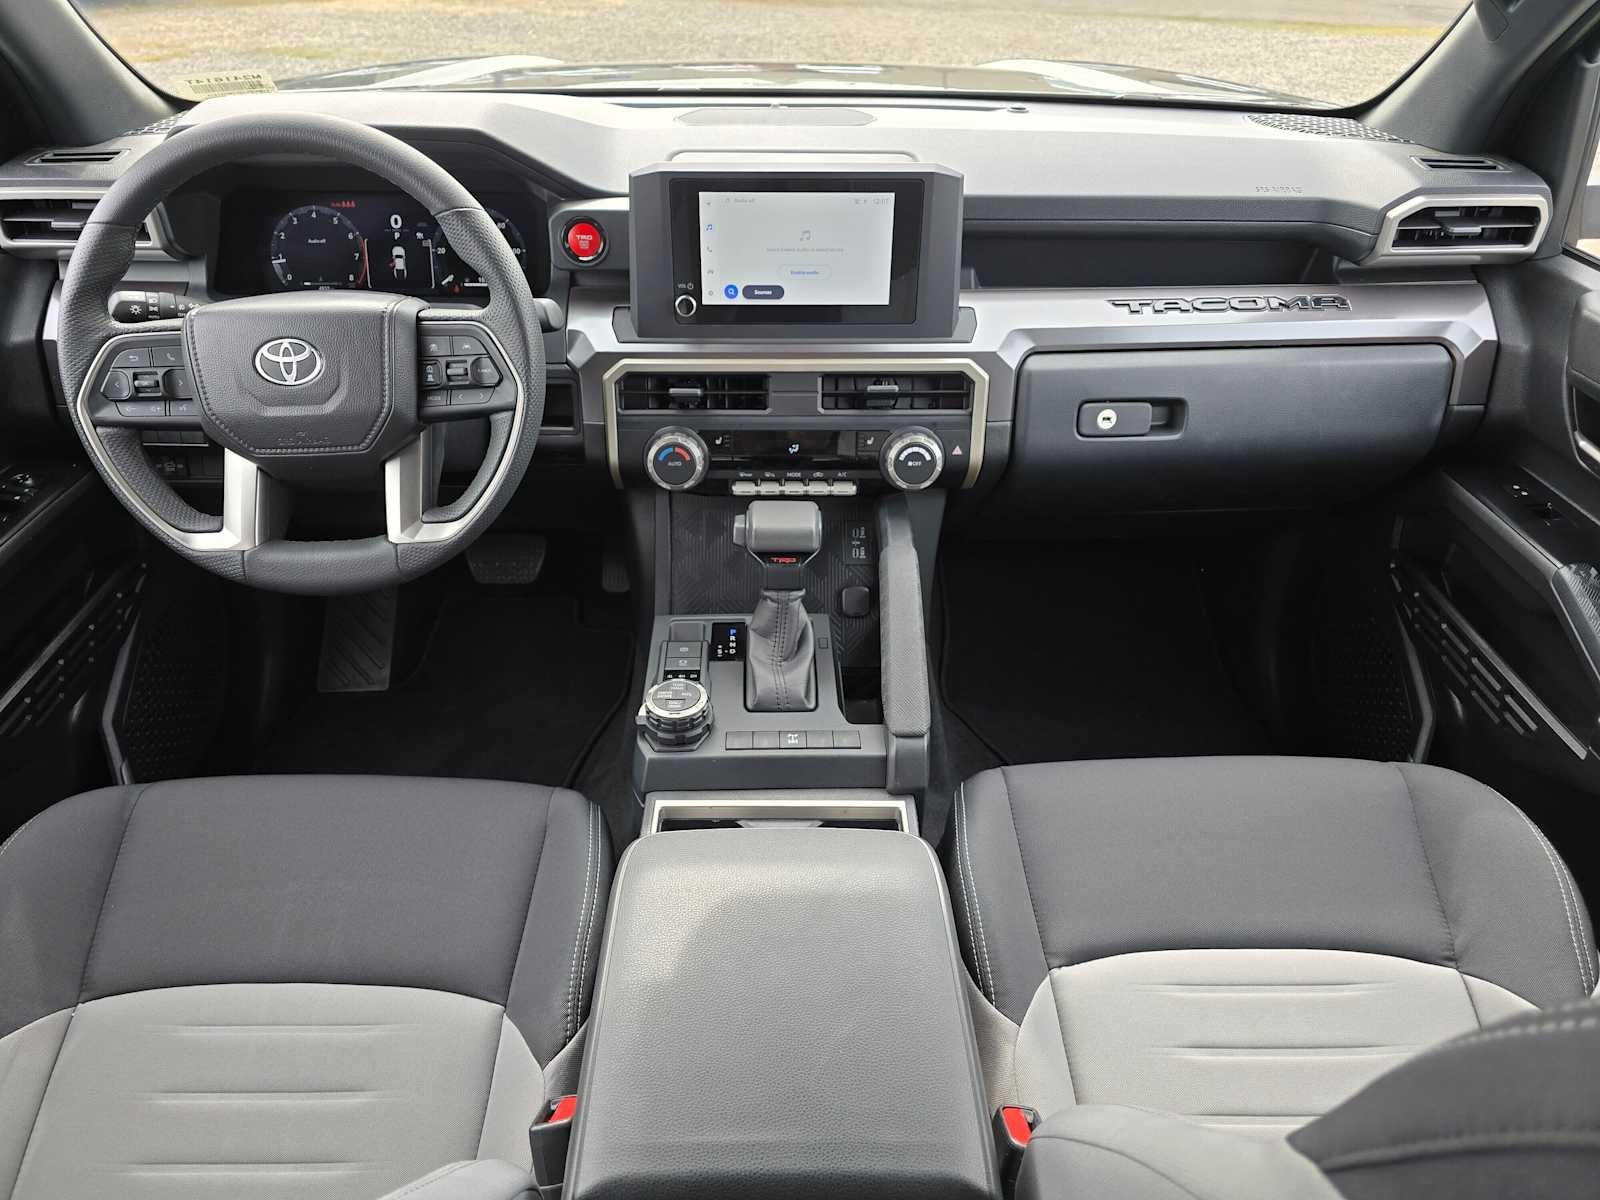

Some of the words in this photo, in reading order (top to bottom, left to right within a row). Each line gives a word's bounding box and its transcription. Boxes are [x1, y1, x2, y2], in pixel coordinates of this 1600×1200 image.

[311, 211, 317, 219] 4
[293, 217, 298, 225] 3
[333, 217, 339, 225] 5
[390, 214, 402, 229] 0
[280, 232, 286, 240] 2
[348, 232, 354, 240] 6
[394, 232, 400, 240] P
[437, 247, 446, 255] 20
[354, 253, 360, 261] 7
[1106, 294, 1352, 315] TACOMA
